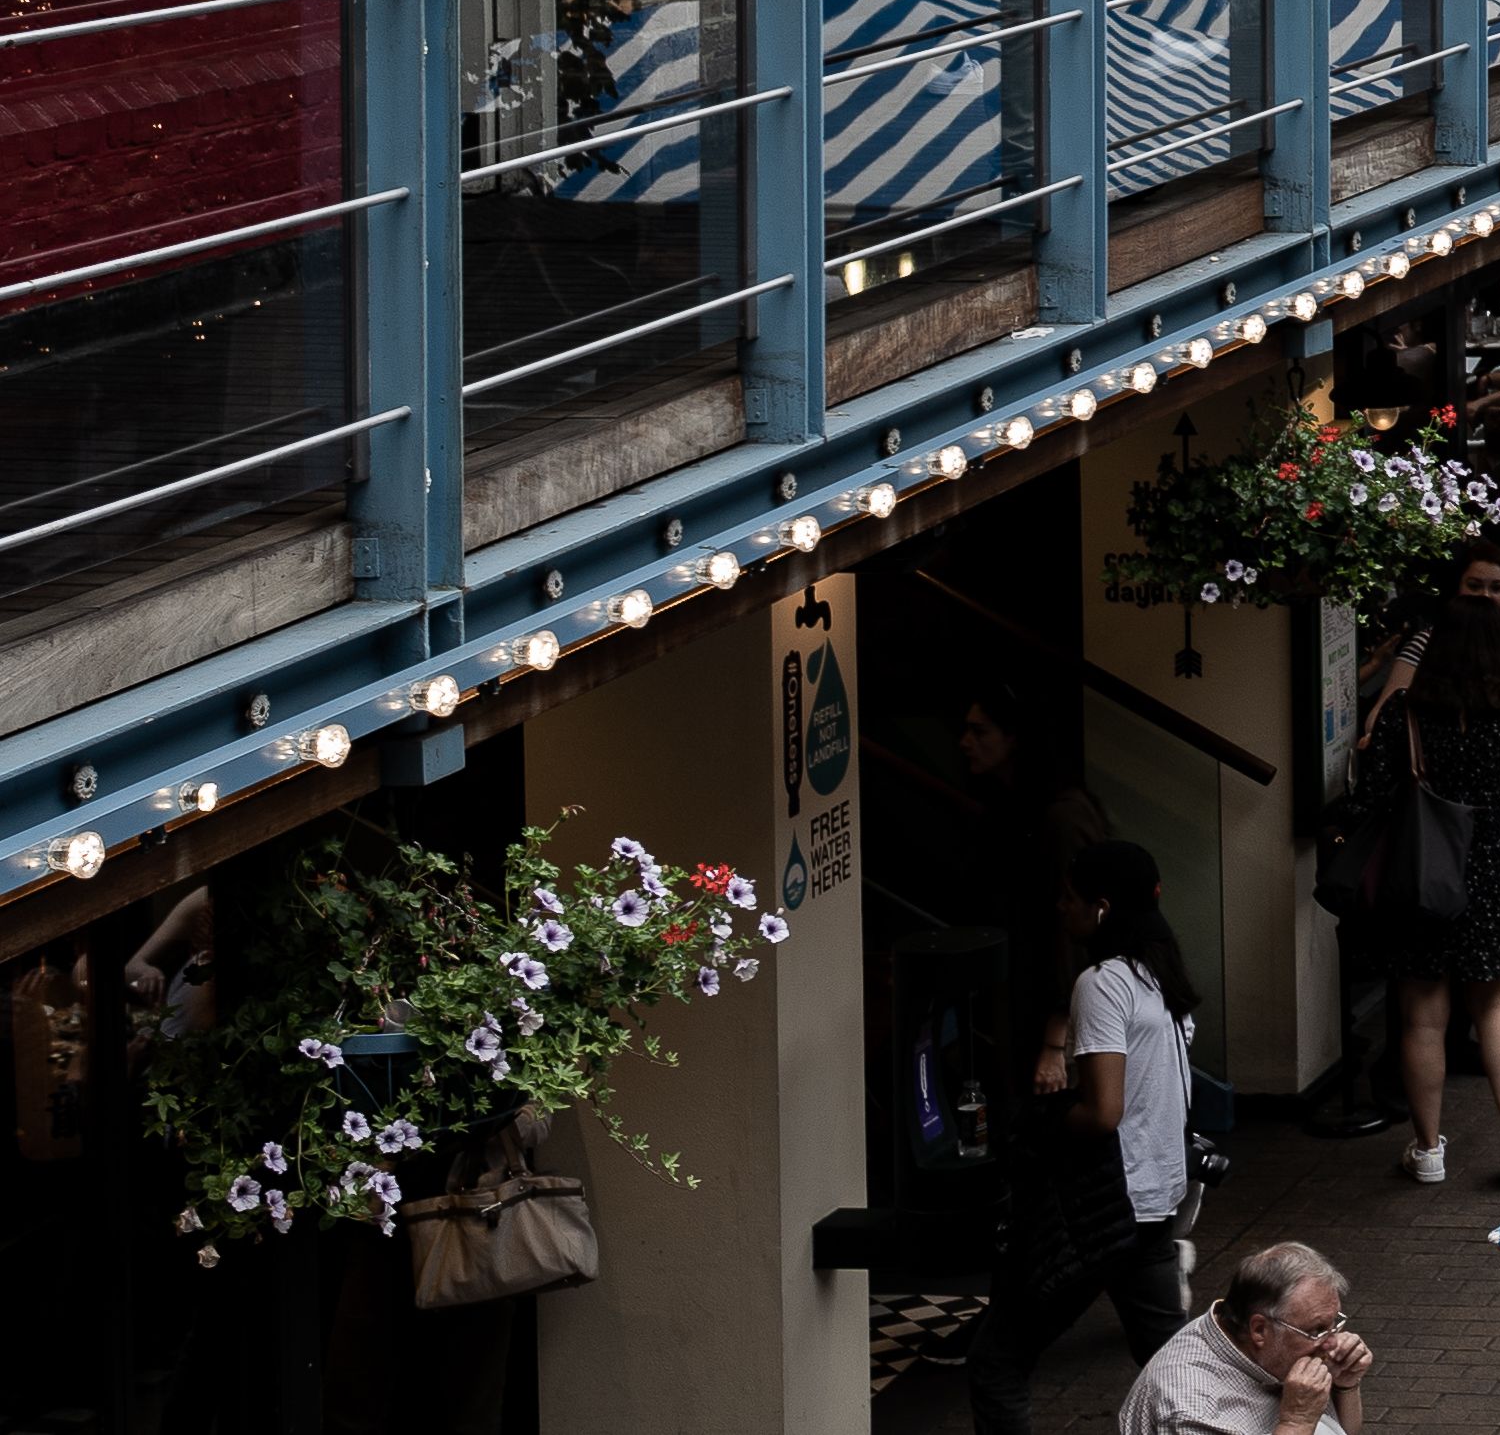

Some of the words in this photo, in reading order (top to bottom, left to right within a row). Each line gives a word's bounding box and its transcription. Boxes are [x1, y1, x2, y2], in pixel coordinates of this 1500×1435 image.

[813, 700, 845, 727] REFILL
[818, 721, 839, 743] NOT
[808, 736, 851, 770] LANDFILL
[811, 799, 851, 845] FREE
[811, 830, 851, 871] WATER
[812, 854, 852, 900] HERE
